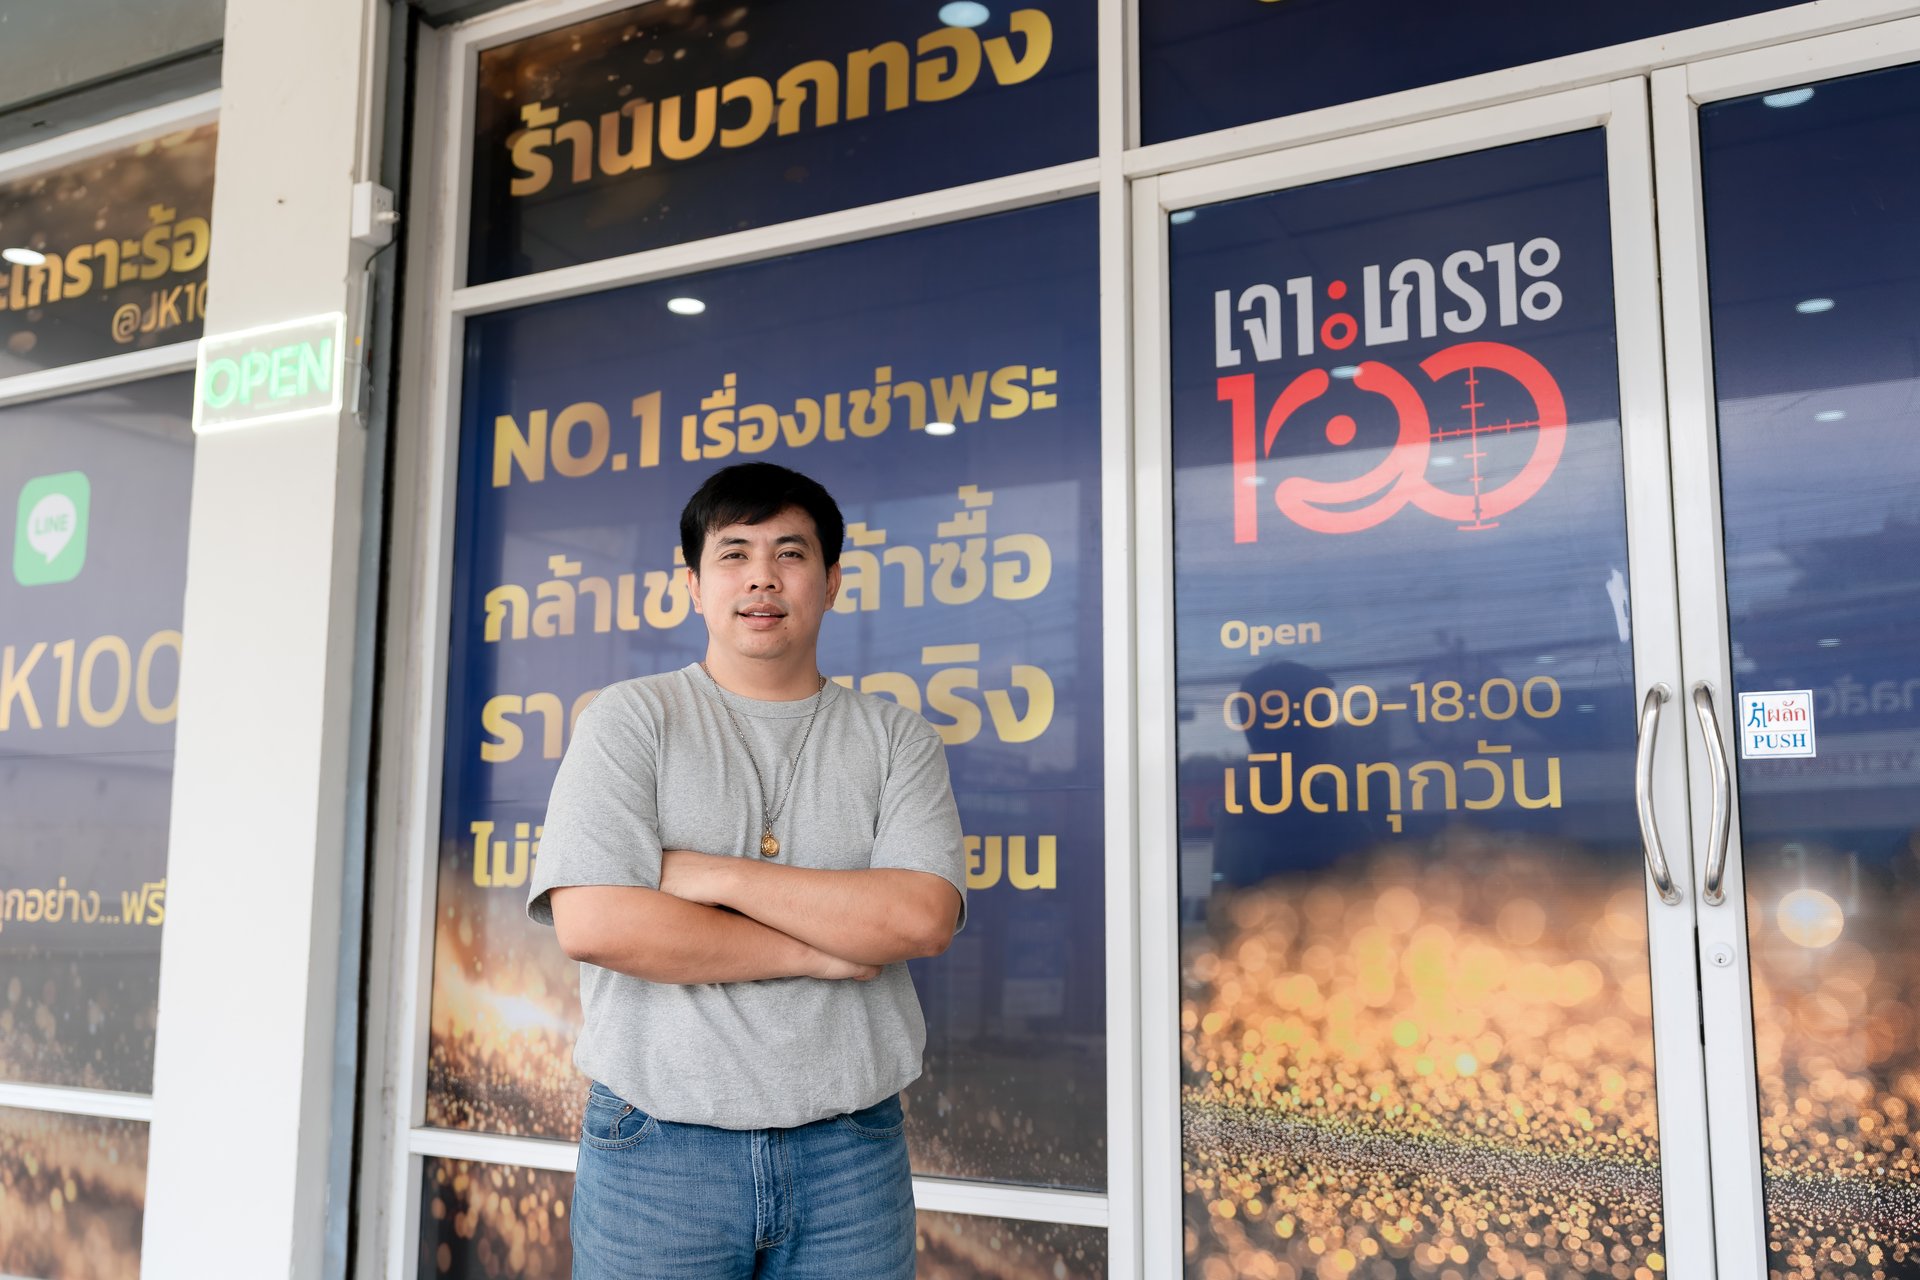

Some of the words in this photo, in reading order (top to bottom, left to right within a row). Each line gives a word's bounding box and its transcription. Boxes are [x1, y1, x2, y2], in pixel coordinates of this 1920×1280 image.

[510, 8, 1053, 196] ร้านบวกทอง
[1215, 237, 1563, 368] เจาะเกราะ
[204, 336, 332, 409] OPEN
[492, 390, 662, 488] NO.1
[681, 365, 1058, 462] เรื่องเช่าพระ
[34, 513, 70, 536] LINE
[1220, 620, 1321, 655] Open
[1753, 733, 1806, 748] PUSH
[1767, 700, 1806, 722] ผลัก
[1224, 739, 1562, 833] เปิดทุกวัน
[470, 820, 544, 888] ไม่
[0, 876, 166, 934] กอย่าง...ฟรี
